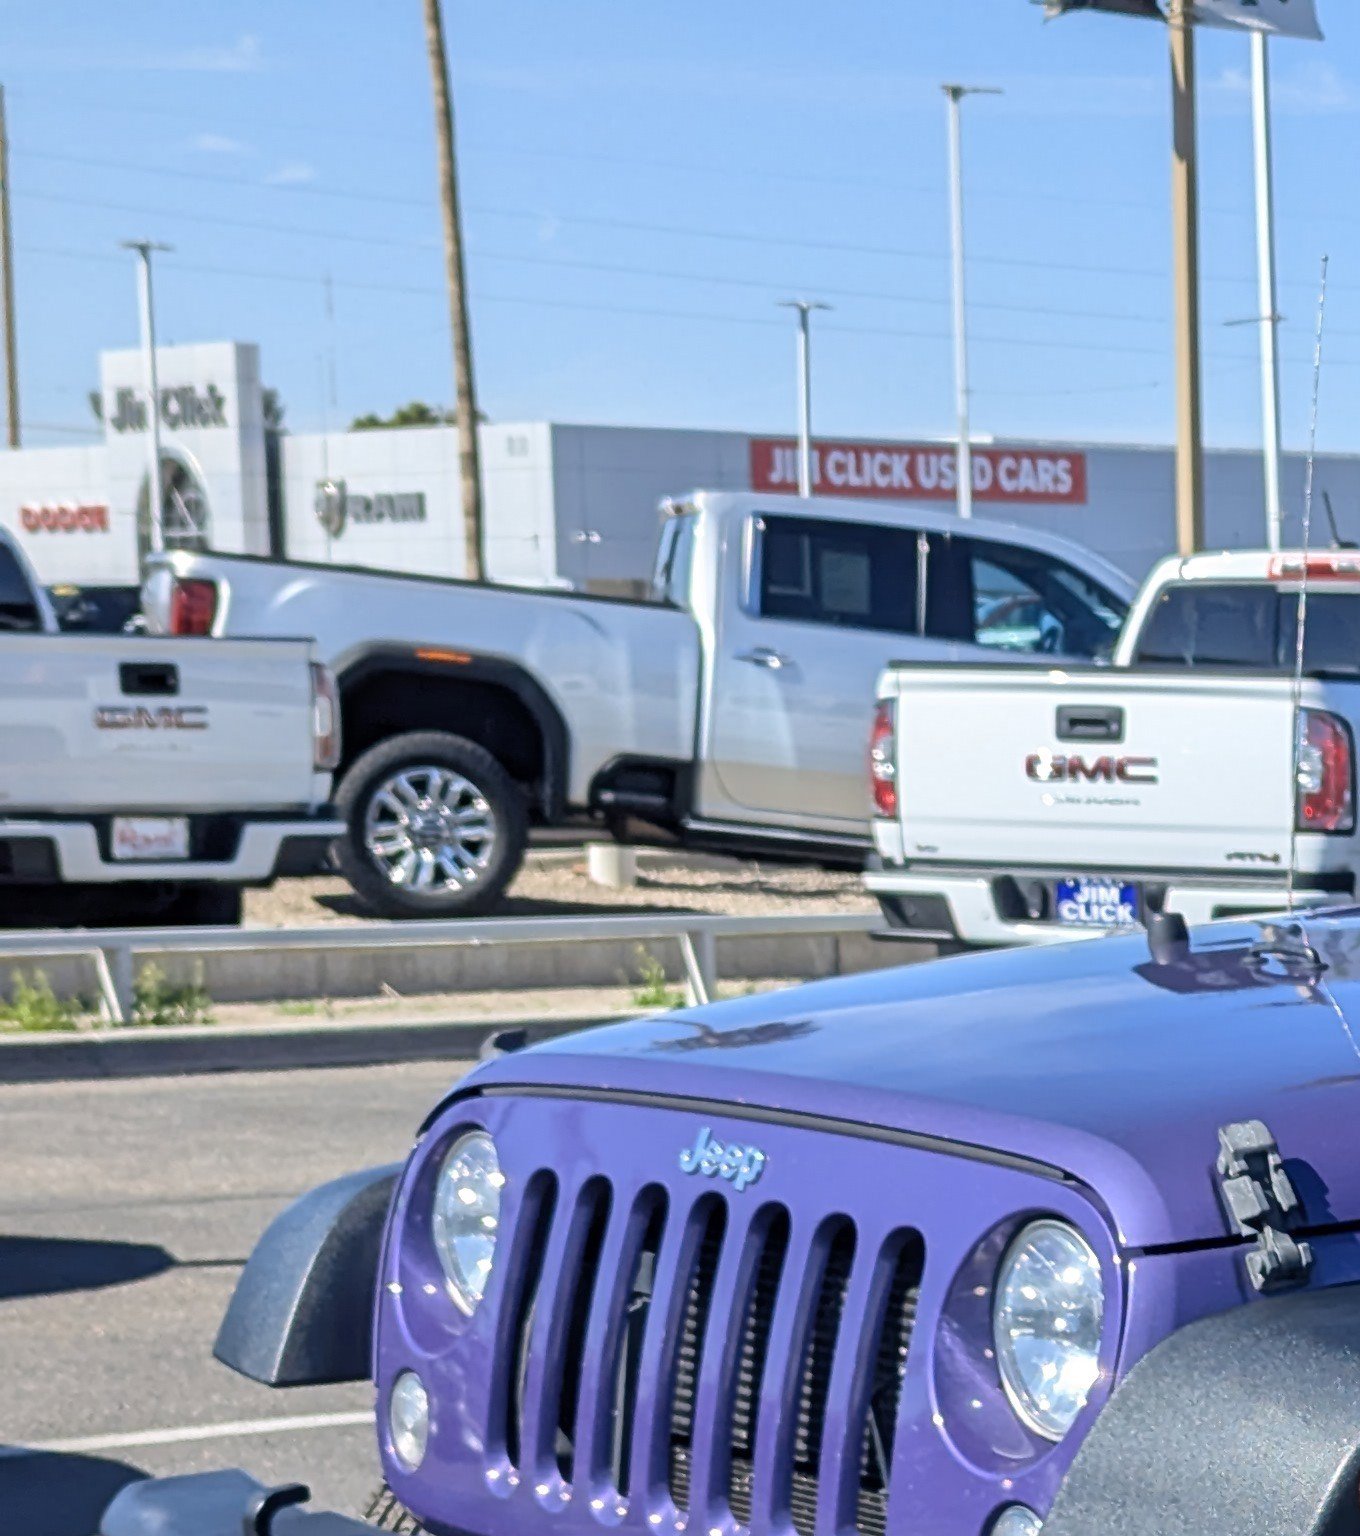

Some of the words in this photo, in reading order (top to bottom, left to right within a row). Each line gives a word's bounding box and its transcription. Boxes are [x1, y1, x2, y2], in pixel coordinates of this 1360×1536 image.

[826, 449, 913, 489] CLICK
[915, 453, 993, 491] USD
[998, 455, 1073, 494] CARS
[95, 706, 209, 730] GMC
[1025, 753, 1158, 784] GMC
[1073, 886, 1120, 904] JIM
[1058, 898, 1134, 922] CLICK
[679, 1126, 766, 1192] Jeep
